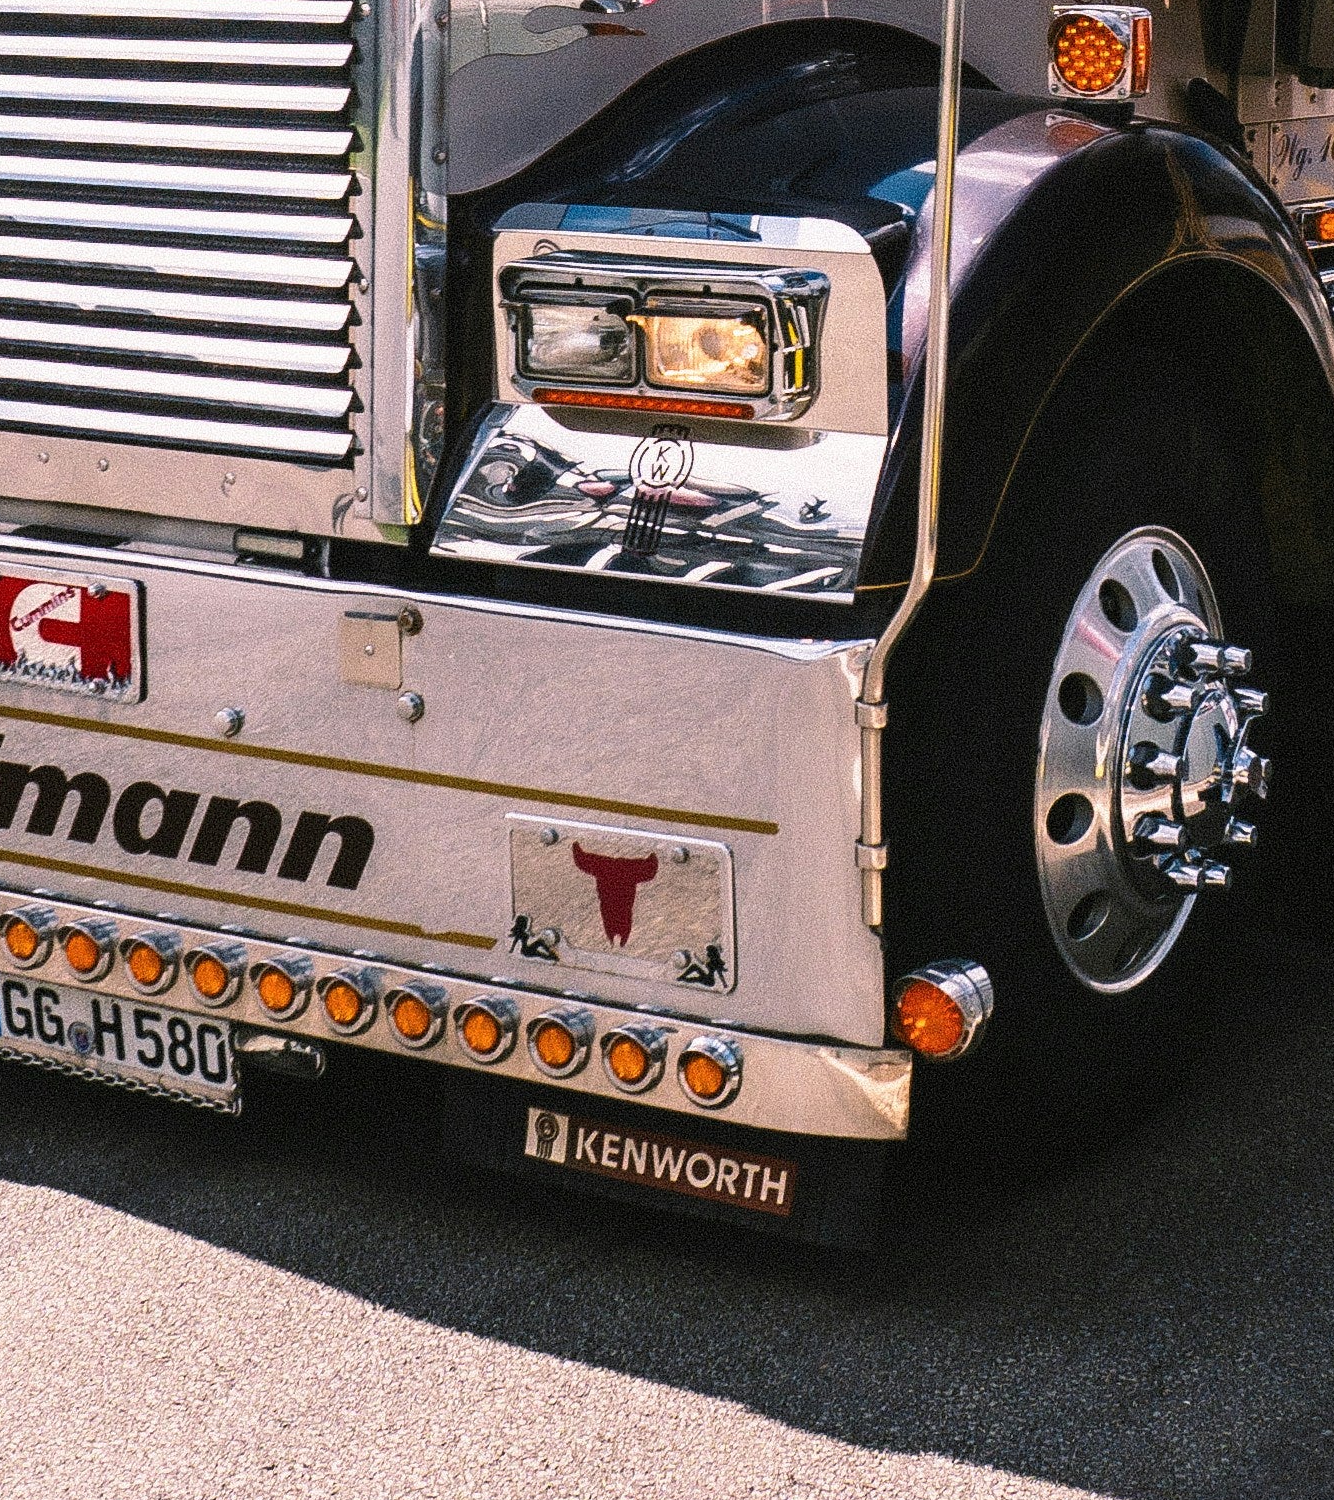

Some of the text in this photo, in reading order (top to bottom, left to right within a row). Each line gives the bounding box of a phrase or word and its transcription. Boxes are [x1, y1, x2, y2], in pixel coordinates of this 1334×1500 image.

[10, 586, 77, 632] Cummins
[1, 978, 67, 1046] GG
[133, 1008, 229, 1085] 580
[575, 1128, 789, 1208] KENWORTH
